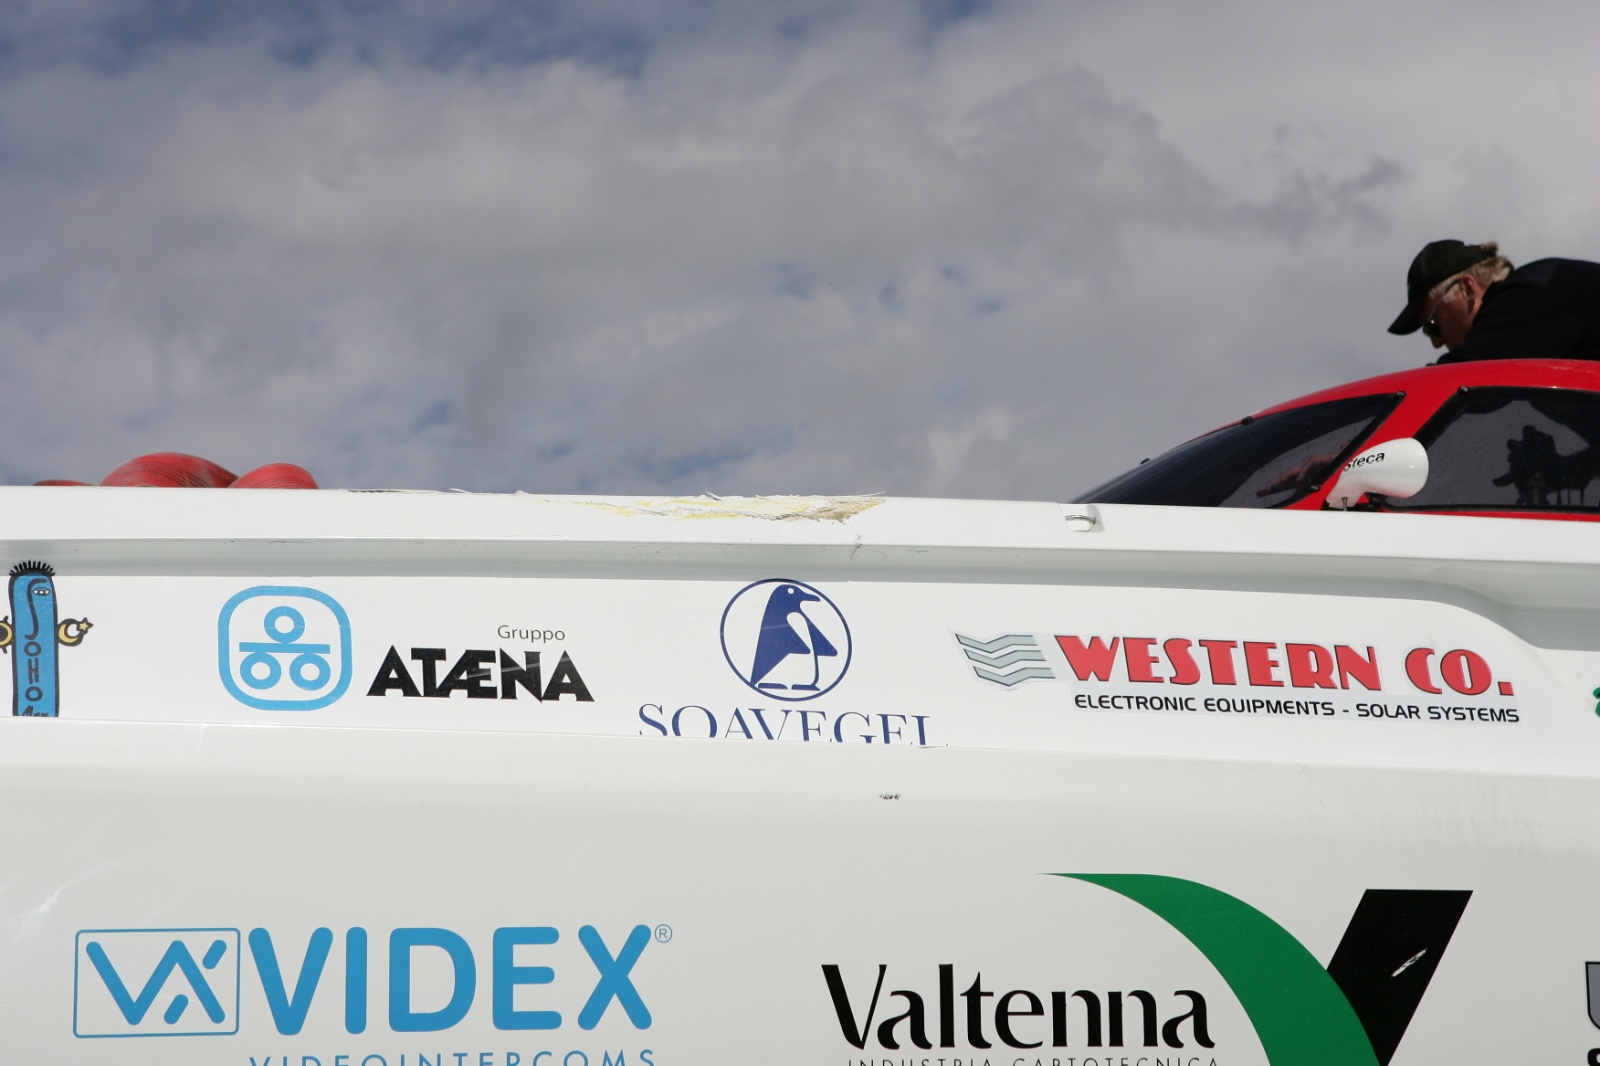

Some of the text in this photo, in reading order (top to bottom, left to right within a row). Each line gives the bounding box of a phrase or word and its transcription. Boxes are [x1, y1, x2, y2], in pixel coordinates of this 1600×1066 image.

[1343, 452, 1386, 472] Steca
[497, 624, 566, 644] Gruppo
[1056, 635, 1515, 697] WESTERN CO.
[1074, 694, 1197, 712] ELECTRONIC
[1203, 697, 1335, 717] EQUIPMENTS
[1355, 702, 1421, 719] SOLAR
[1427, 705, 1520, 724] SYSTEMS
[821, 963, 1216, 1050] Valtenna
